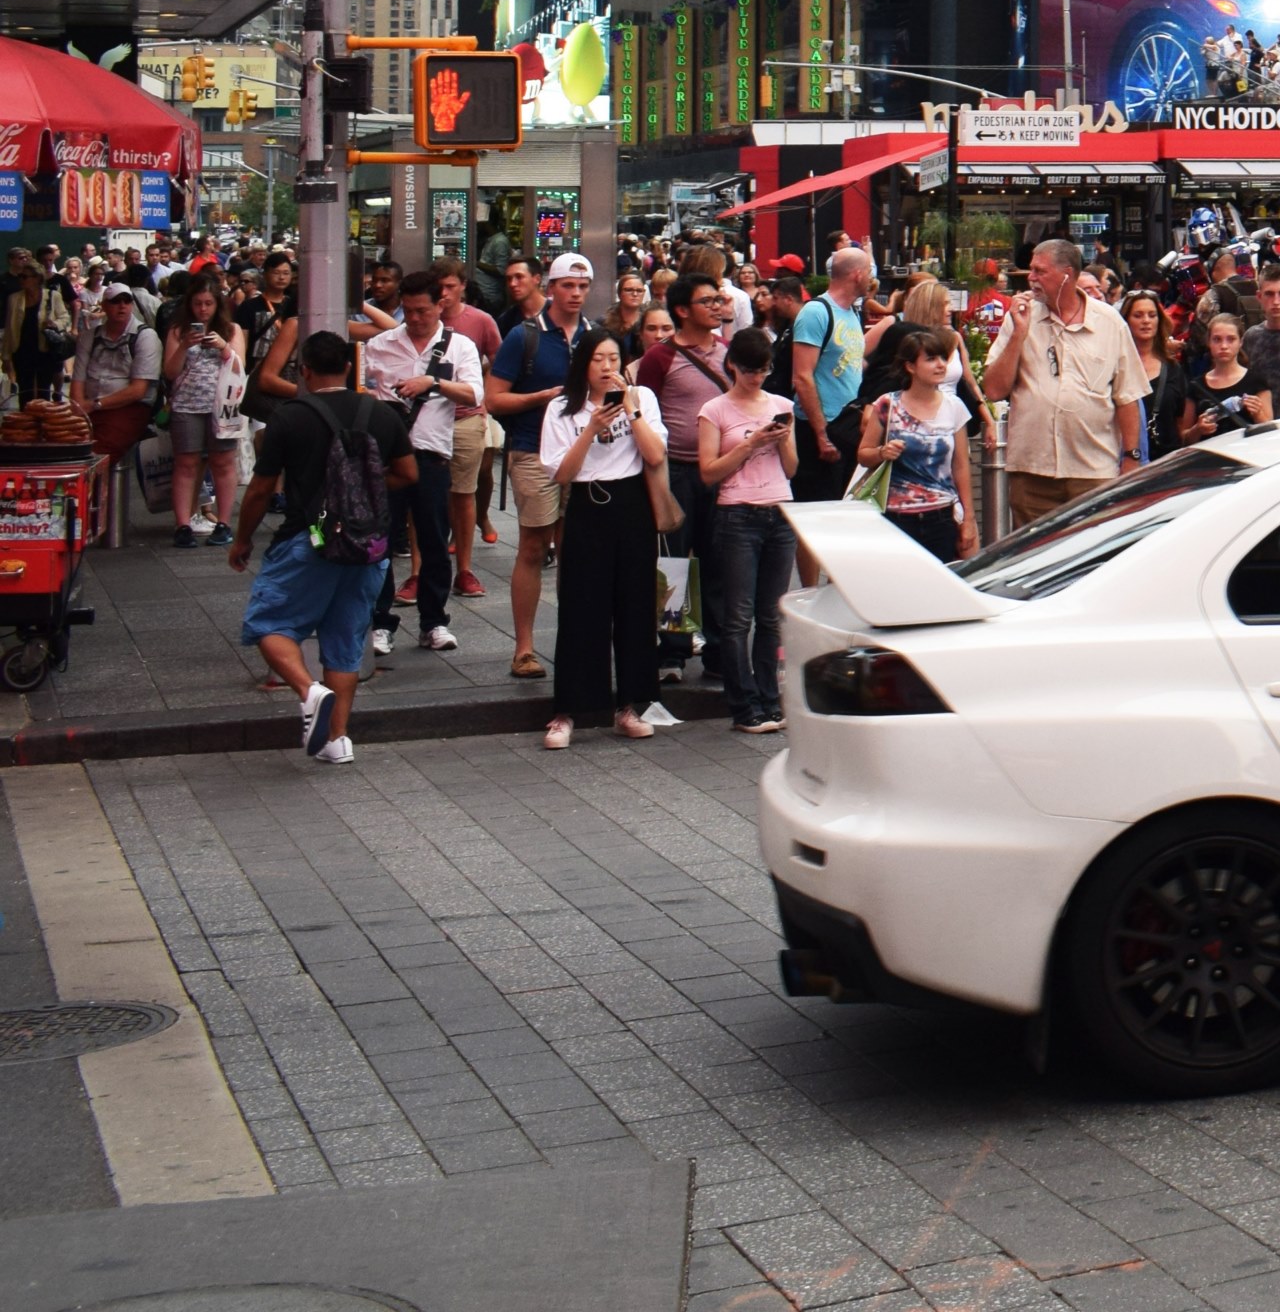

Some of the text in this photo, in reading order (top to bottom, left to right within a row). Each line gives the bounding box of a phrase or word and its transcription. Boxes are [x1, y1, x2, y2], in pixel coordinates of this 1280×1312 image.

[738, 56, 749, 123] GARDEN
[974, 116, 1074, 127] PEDESTRIAN FLOW ZONE
[1175, 107, 1217, 130] NYC
[1019, 130, 1074, 142] KEEP MOVING
[113, 149, 172, 168] thirsty?
[141, 177, 164, 185] JOHN'S
[968, 175, 1166, 186] EMPANADAS PASTRIES DRAFT BEER WINE COFFEE
[141, 194, 166, 203] FAMOUS
[153, 208, 166, 217] DOG
